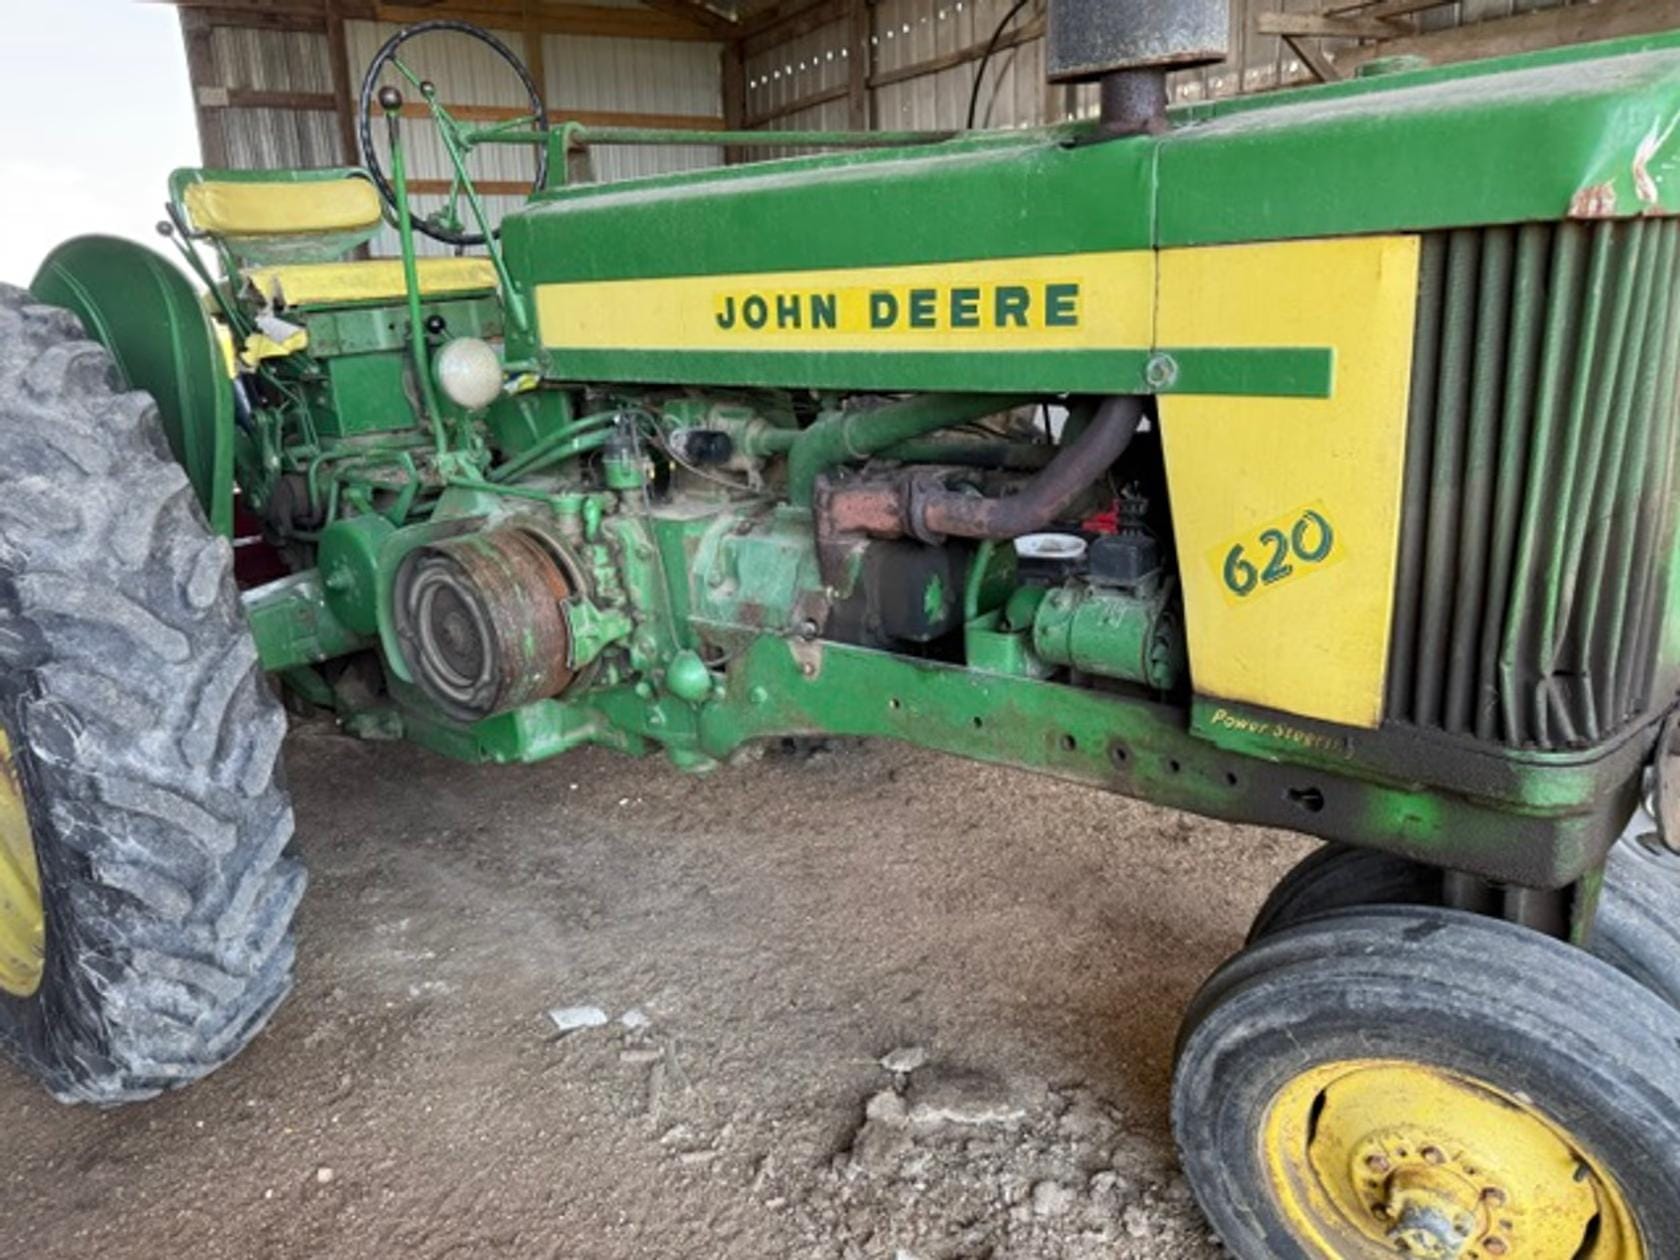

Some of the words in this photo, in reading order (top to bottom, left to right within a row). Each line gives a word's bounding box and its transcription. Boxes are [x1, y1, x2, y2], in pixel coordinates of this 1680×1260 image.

[716, 293, 837, 330] JOHN
[869, 283, 1080, 329] DEERE
[1223, 509, 1334, 597] 620
[1211, 708, 1268, 734] Power
